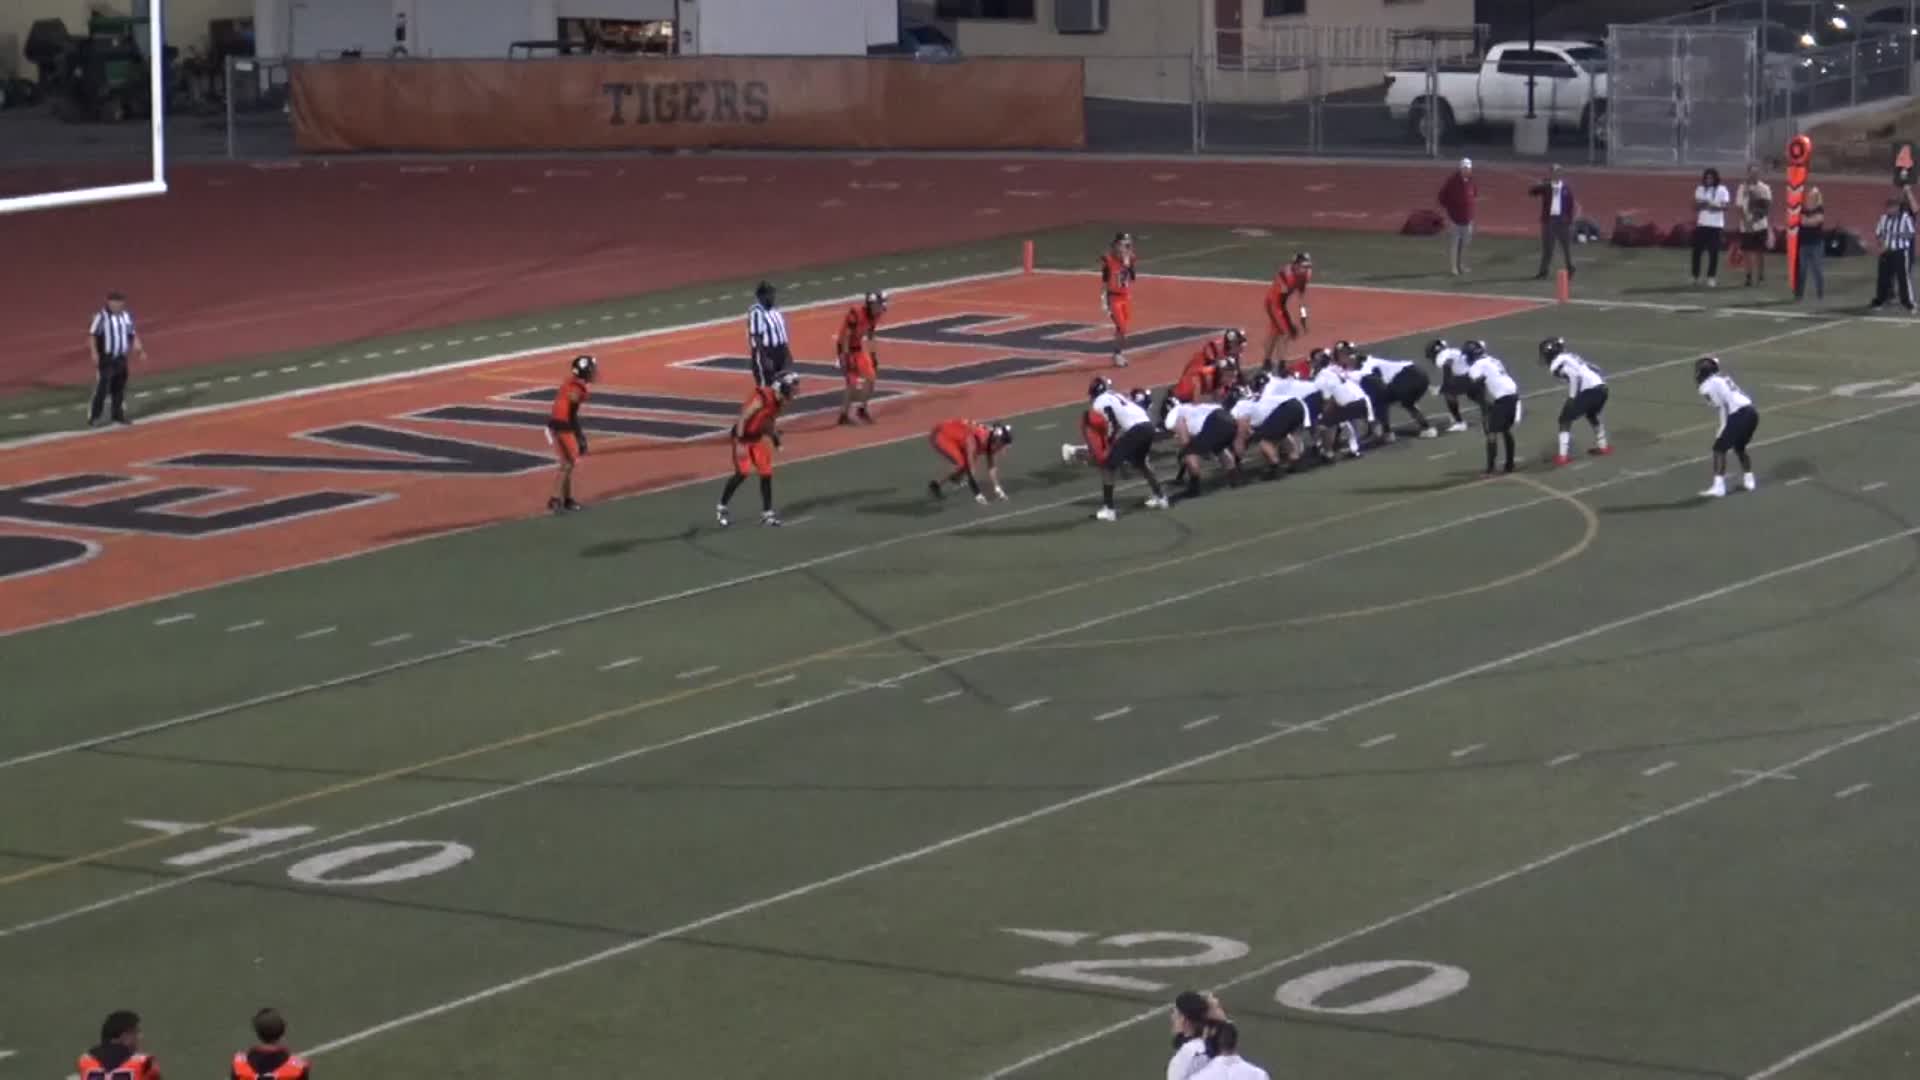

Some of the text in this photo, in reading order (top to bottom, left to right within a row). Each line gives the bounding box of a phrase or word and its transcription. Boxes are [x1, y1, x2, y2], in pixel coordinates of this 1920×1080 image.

[602, 80, 769, 125] TIGERS
[160, 824, 475, 885] 10
[1015, 931, 1471, 1015] 20
